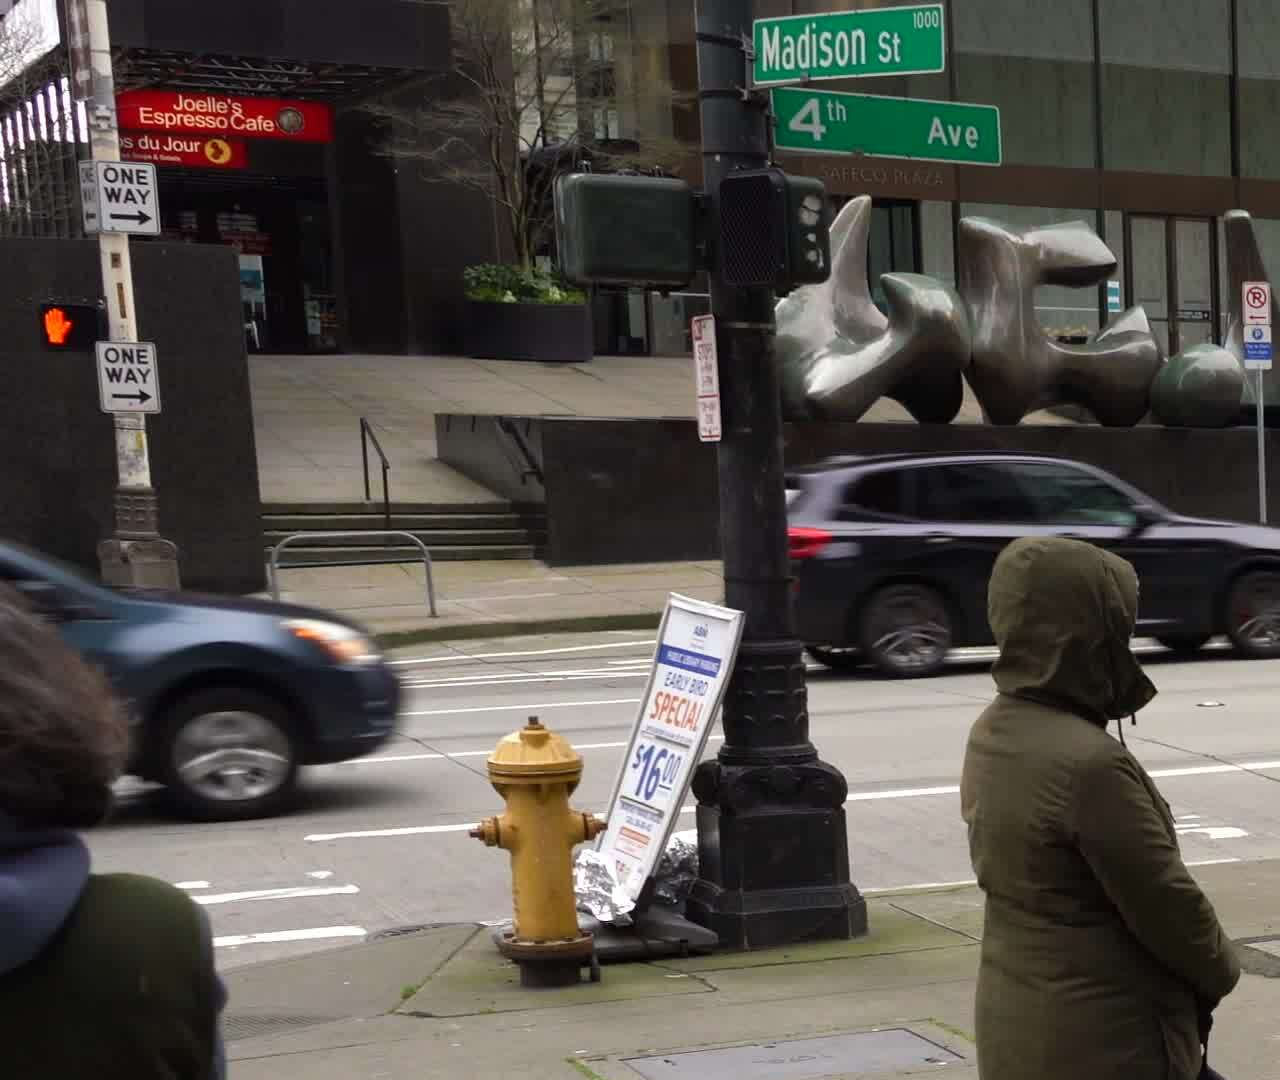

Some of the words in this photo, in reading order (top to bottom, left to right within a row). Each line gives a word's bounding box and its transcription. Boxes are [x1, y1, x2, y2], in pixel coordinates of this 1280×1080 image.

[913, 11, 940, 29] 1000
[761, 23, 866, 72] Madison
[878, 31, 901, 64] St
[173, 94, 243, 115] Joelle's
[139, 107, 228, 129] Espresso
[230, 112, 275, 132] Cafe
[788, 98, 847, 141] 4th
[927, 116, 979, 149] Ave
[138, 135, 160, 150] du
[163, 136, 201, 152] Jour
[103, 167, 149, 186] ONE
[103, 187, 151, 205] WAY
[104, 347, 149, 365] ONE
[104, 367, 151, 384] WAY
[664, 671, 690, 692] EARLY
[688, 676, 708, 697] BIRD
[650, 691, 704, 731] SPECIAL
